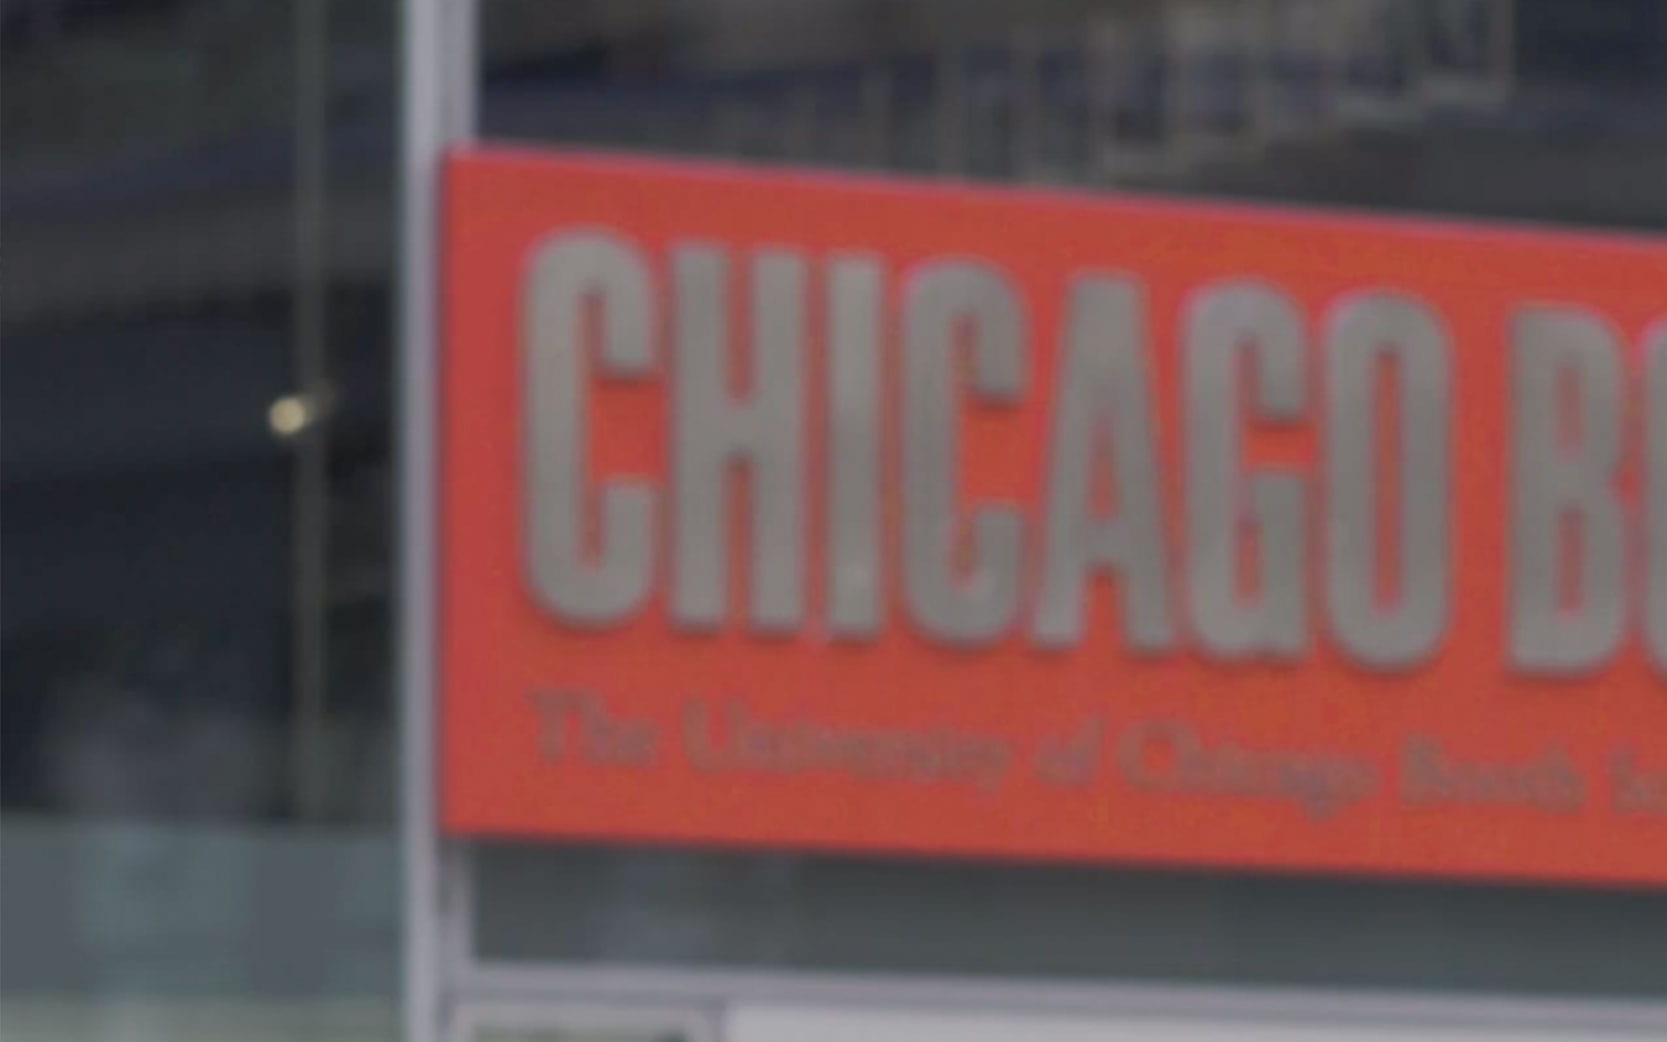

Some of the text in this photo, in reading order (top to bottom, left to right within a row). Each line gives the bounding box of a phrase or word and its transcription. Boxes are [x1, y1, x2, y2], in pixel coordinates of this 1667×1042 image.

[521, 228, 1453, 672] CHICAGO
[525, 685, 660, 768] The
[1032, 713, 1108, 788] of
